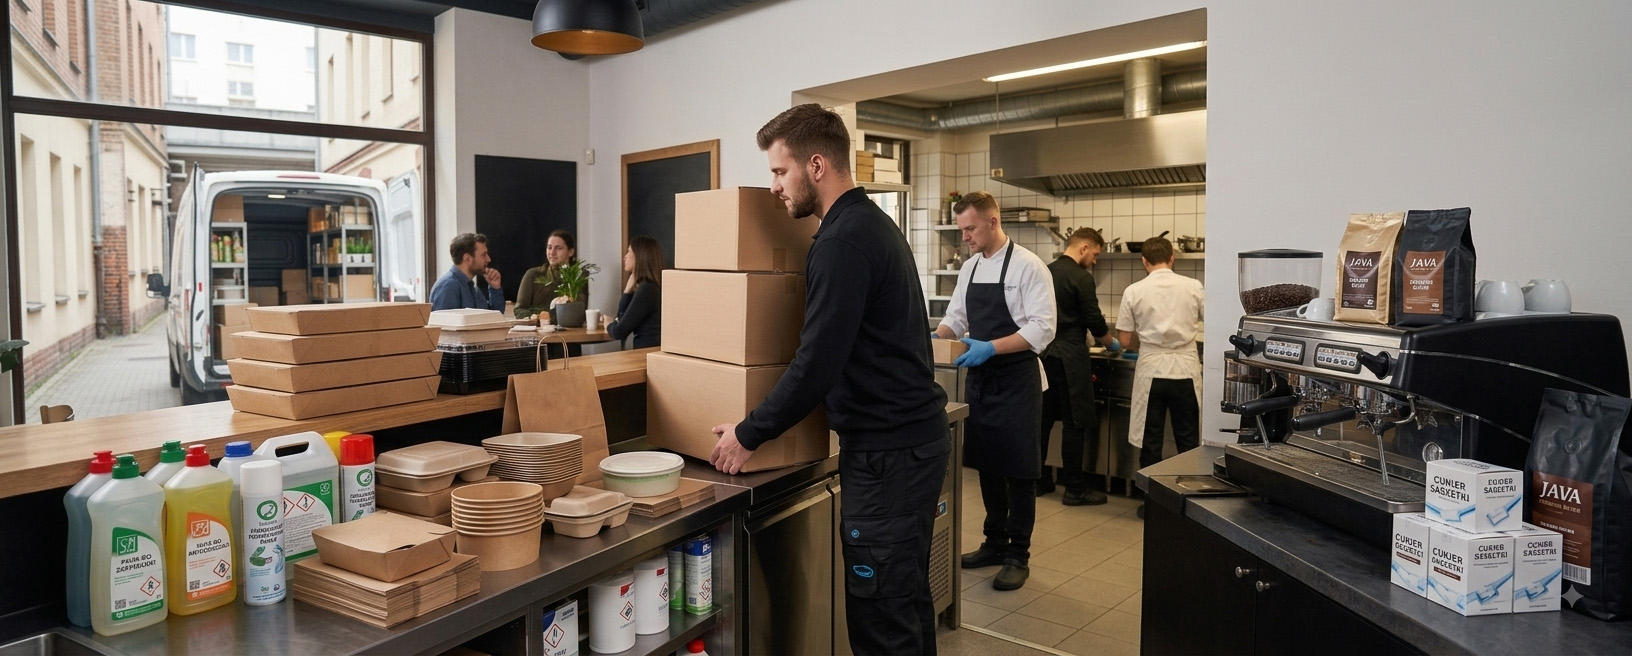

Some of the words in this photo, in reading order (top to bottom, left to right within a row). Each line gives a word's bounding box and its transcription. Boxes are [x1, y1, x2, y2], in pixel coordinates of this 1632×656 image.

[1350, 258, 1373, 267] JAVA
[1410, 258, 1437, 268] JAVA
[1539, 481, 1582, 505] JAVA
